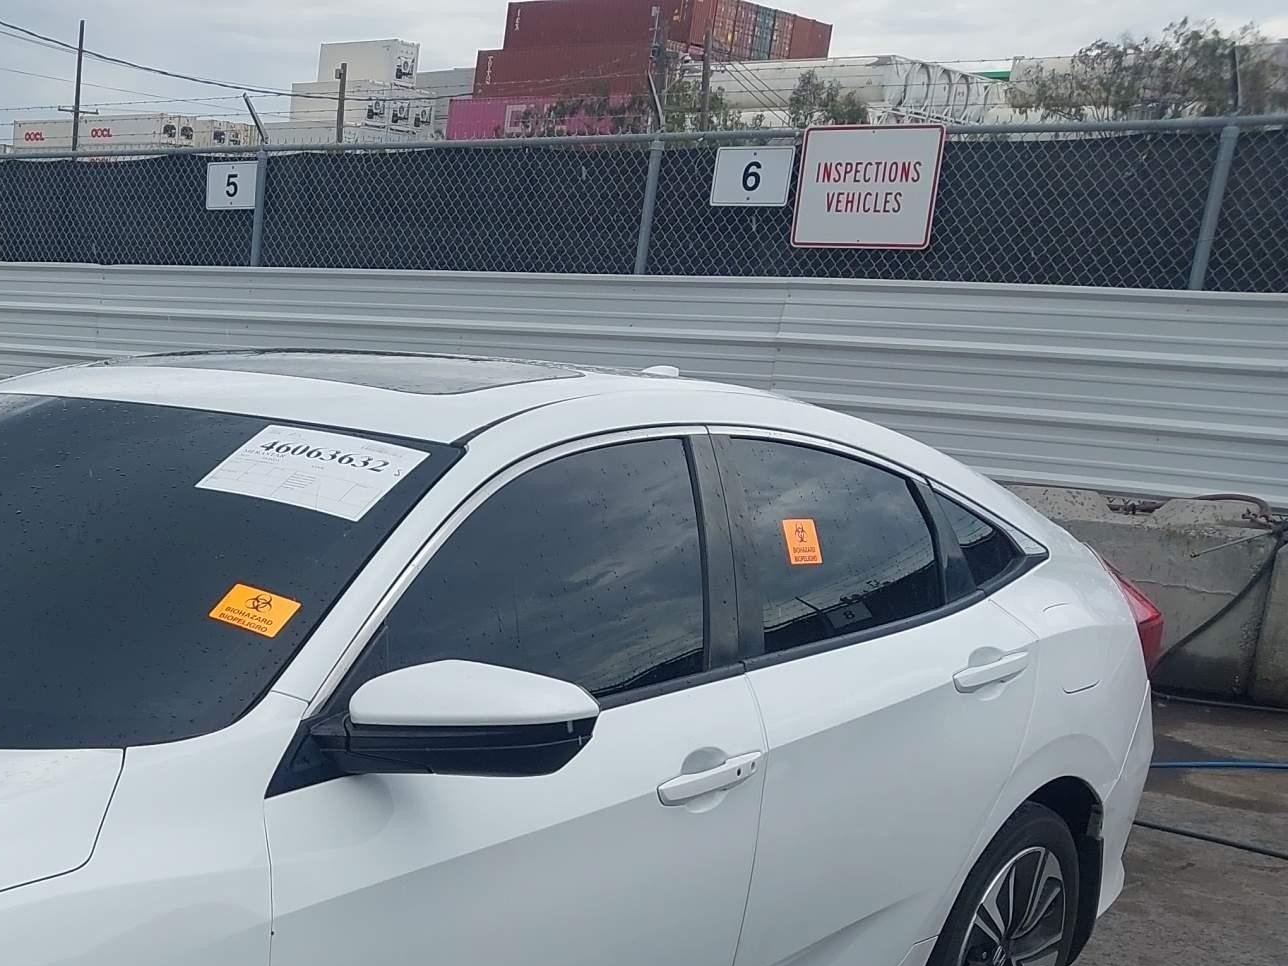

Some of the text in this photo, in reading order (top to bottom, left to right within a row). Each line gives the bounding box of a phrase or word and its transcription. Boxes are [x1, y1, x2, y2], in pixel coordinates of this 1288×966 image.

[24, 131, 45, 141] OOCL
[91, 128, 112, 138] OOCL
[742, 160, 762, 191] 6
[815, 160, 923, 184] INSPECTIONS
[225, 173, 239, 198] 5
[826, 191, 903, 214] VEHICLES
[260, 440, 390, 473] 46063632
[219, 612, 268, 633] BIOPELIGRO
[225, 606, 273, 626] BIOHAZARD
